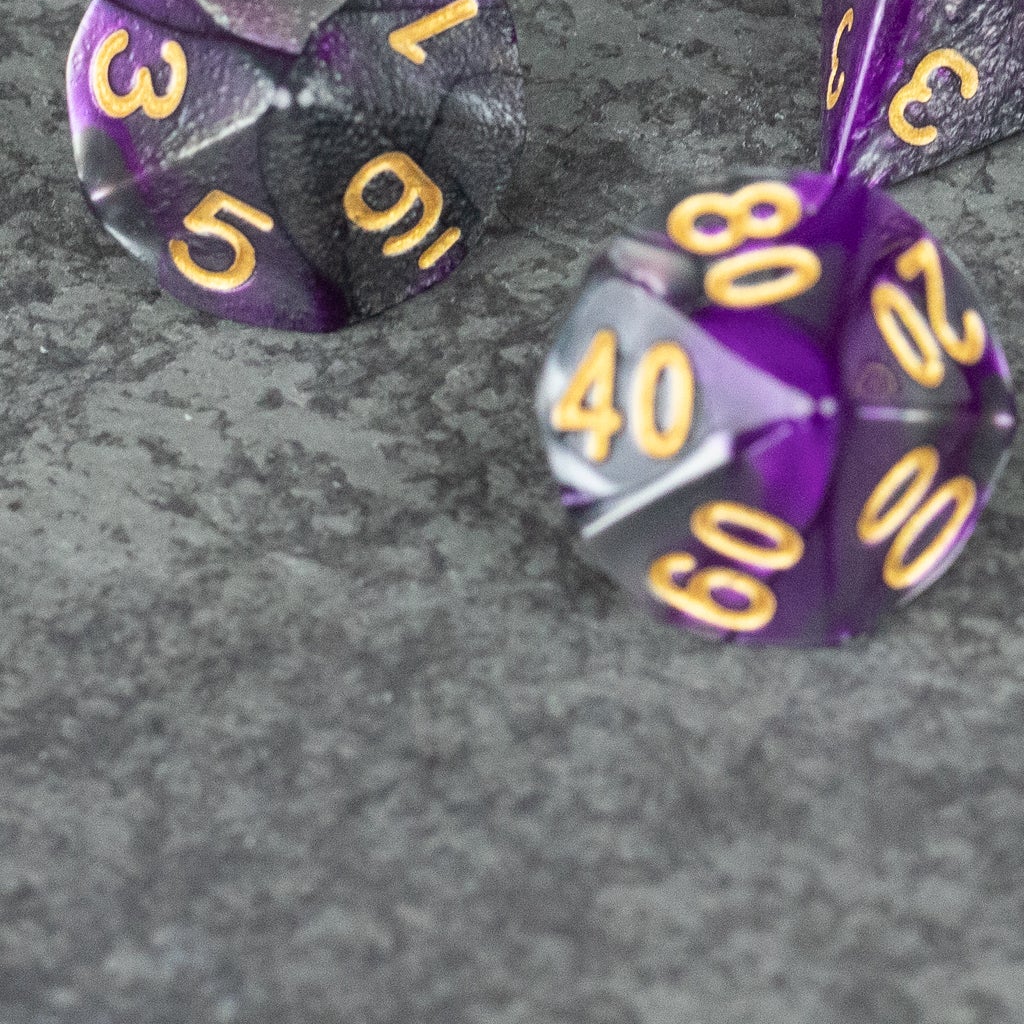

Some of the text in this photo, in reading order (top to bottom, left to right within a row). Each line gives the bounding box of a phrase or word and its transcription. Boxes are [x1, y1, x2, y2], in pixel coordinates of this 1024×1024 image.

[90, 28, 188, 120] 3
[826, 7, 854, 110] 3
[887, 48, 980, 147] 3
[168, 189, 274, 292] 5
[666, 180, 822, 309] 80
[870, 239, 986, 389] 20
[552, 330, 696, 463] 40
[647, 500, 805, 632] 60
[857, 445, 977, 590] 00
